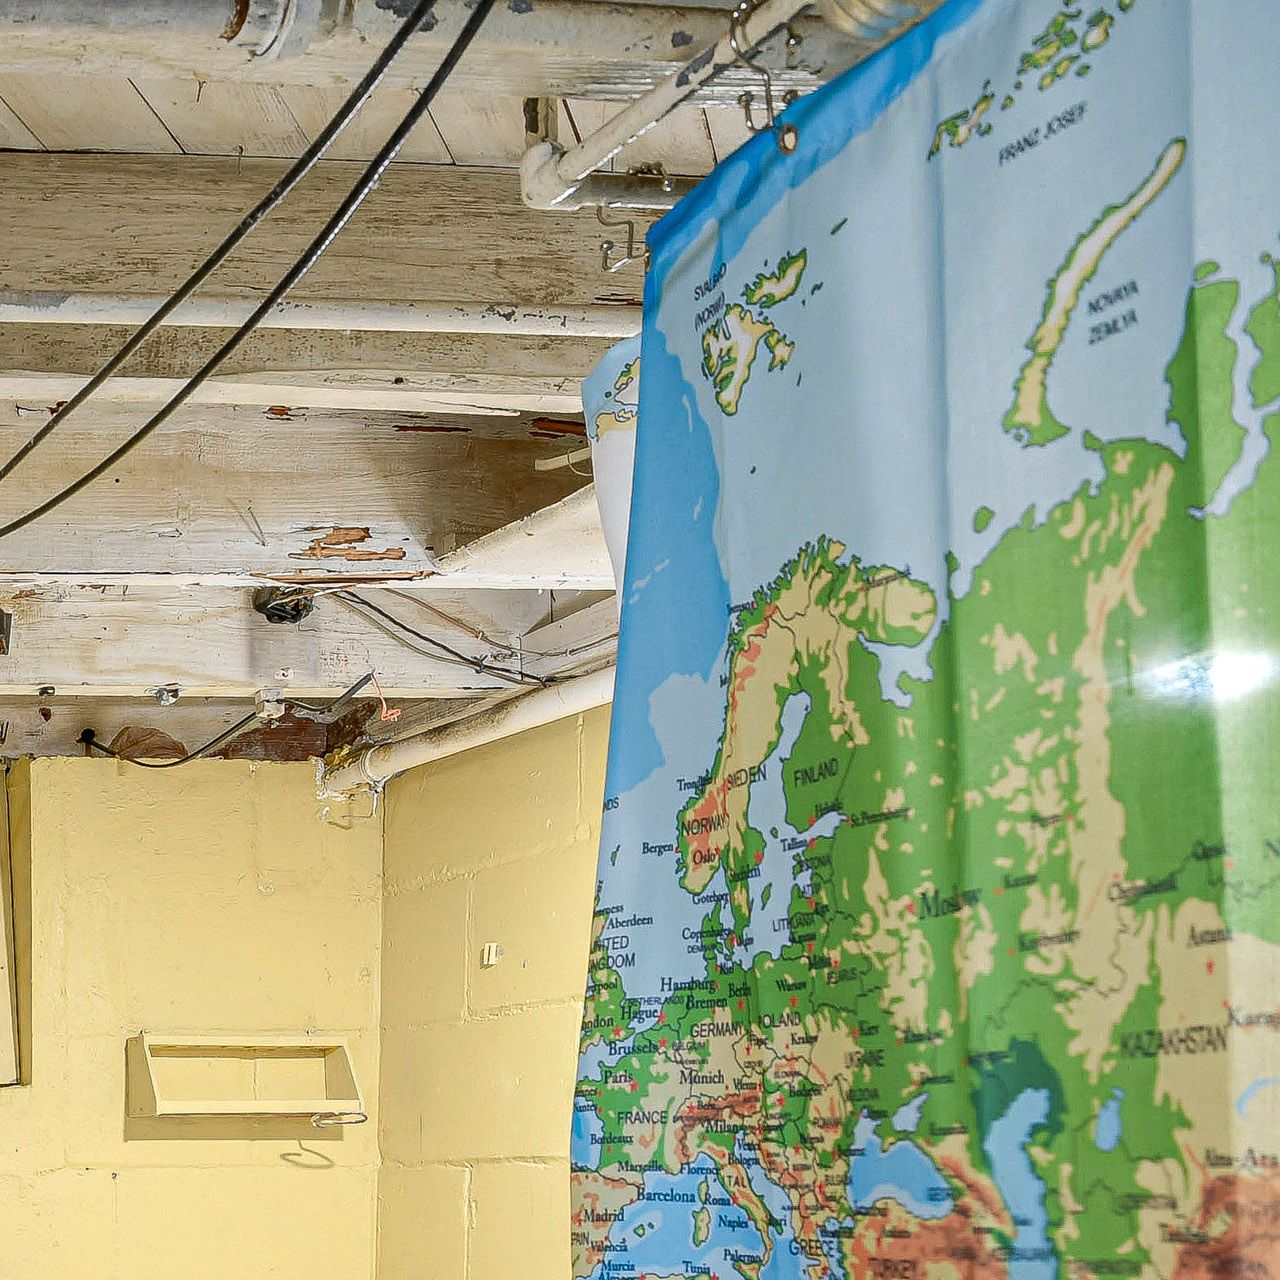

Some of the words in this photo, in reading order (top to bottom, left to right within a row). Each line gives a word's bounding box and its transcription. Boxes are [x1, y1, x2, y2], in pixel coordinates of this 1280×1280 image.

[794, 758, 838, 788] FINLAND
[682, 811, 729, 837] NORWAY
[642, 842, 674, 857] Bergen
[693, 849, 715, 865] Oslo
[606, 914, 654, 930] Aberdeen
[660, 976, 716, 993] Hamburg
[686, 996, 728, 1011] Bremen
[621, 1006, 659, 1024] Hague
[582, 1016, 614, 1031] ondon
[690, 1022, 745, 1038] GERMANY
[609, 1040, 660, 1056] Brussels
[604, 1069, 634, 1085] Paris
[679, 1070, 725, 1086] Munich
[618, 1110, 670, 1125] FRANCE
[590, 1132, 634, 1146] Bordeaux
[636, 1188, 696, 1203] Barcelona
[705, 1194, 731, 1206] Roma
[584, 1208, 625, 1222] Madrid
[602, 1260, 635, 1272] Murcia
[682, 1260, 711, 1274] Tunis
